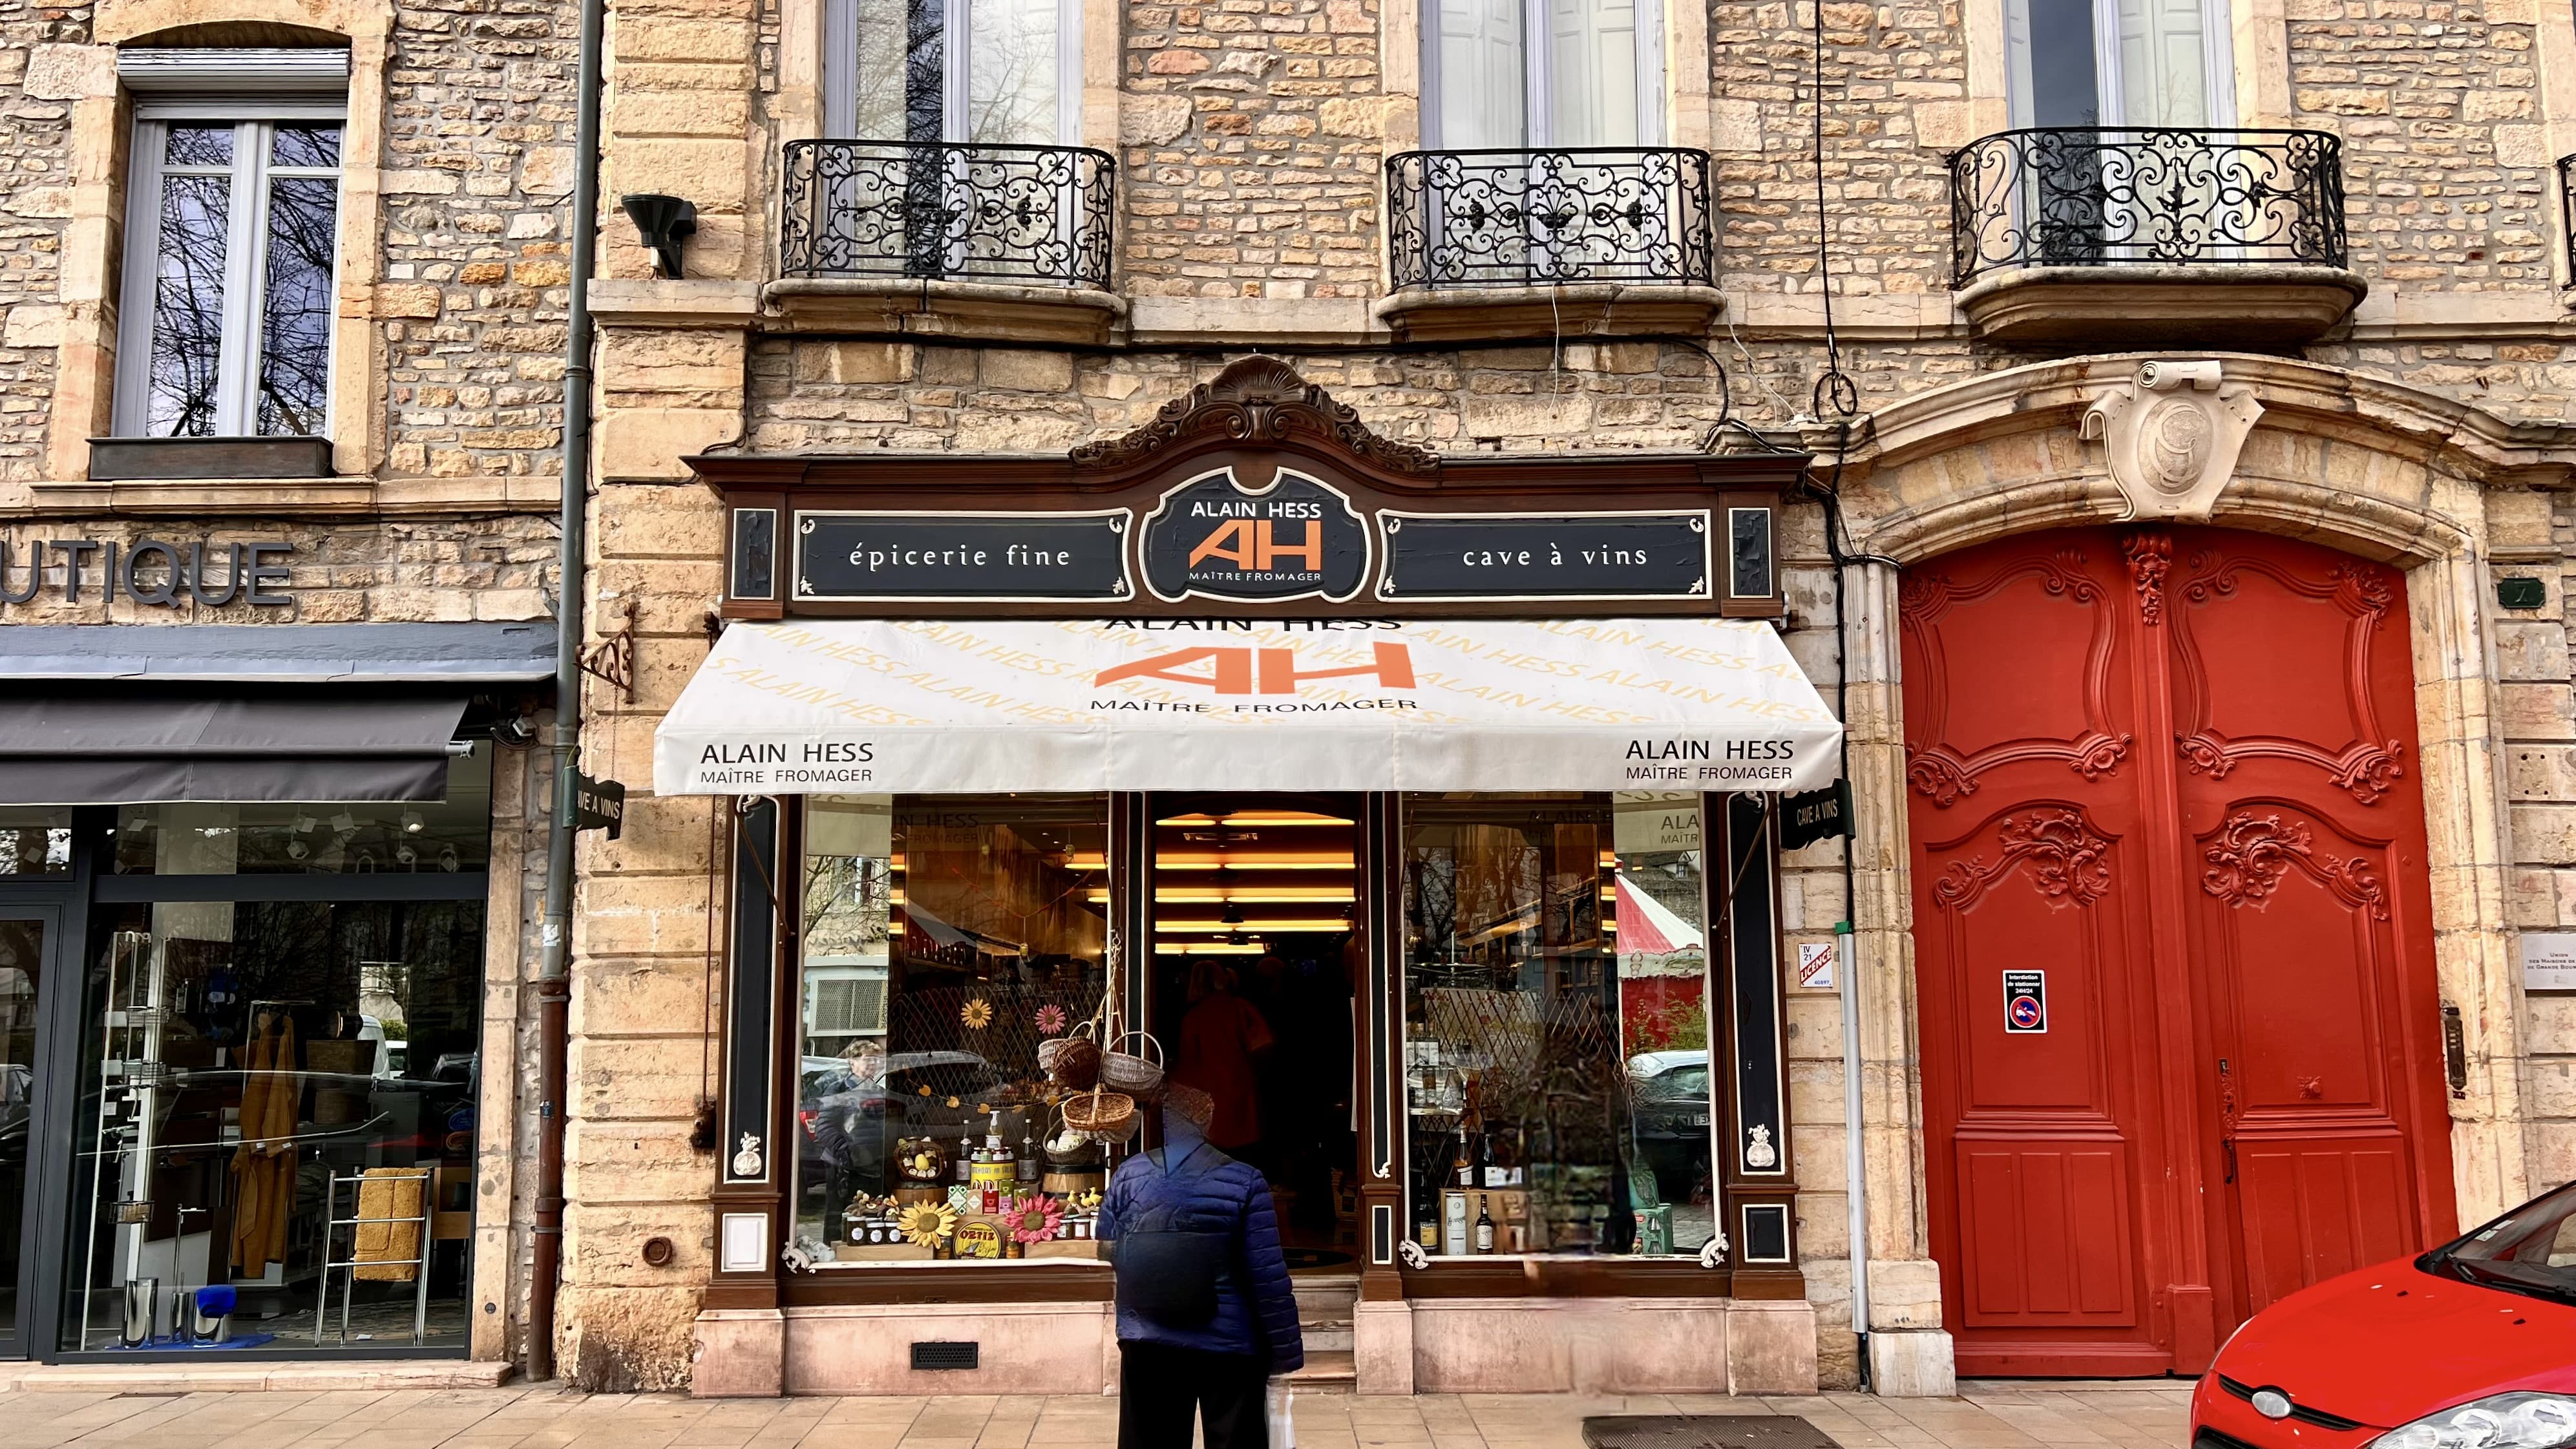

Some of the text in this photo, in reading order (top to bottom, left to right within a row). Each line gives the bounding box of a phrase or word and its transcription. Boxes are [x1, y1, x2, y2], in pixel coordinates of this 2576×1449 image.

[1190, 502, 1322, 518] ALAIN HESS
[849, 542, 1070, 572] épicerie fine
[1188, 520, 1322, 571] AH
[1462, 542, 1647, 566] cave à vins
[0, 540, 293, 609] UTIQUE
[1188, 571, 1322, 582] MAÎTRE FROMAGER
[1054, 621, 1154, 647] LAIN
[1104, 619, 1402, 631] ALAIN HESS
[889, 622, 988, 651] LAIN
[975, 645, 1076, 675] HESS
[1644, 640, 1756, 670] HESS
[739, 623, 826, 648] AIN
[810, 640, 909, 673] HESS
[894, 672, 1016, 708] ALAIN
[1094, 641, 1417, 695] AH
[1214, 620, 1318, 655] LAIN
[1414, 671, 1541, 708] ALAIN
[1387, 622, 1487, 654] LAIN
[1482, 648, 1590, 677] HESS
[1585, 670, 1726, 704] ALAIN
[722, 667, 842, 704] ALAIN
[1090, 699, 1417, 712] MAÎTRE FROMAGER
[701, 743, 874, 764] ALAIN HESS
[1625, 740, 1794, 760] ALAIN HESS
[701, 767, 872, 783] MAÎTRE FROMAGER
[1626, 763, 1793, 780] MAÎTRE FROMAGER
[592, 796, 598, 813] A
[601, 797, 620, 820] VINS
[1797, 798, 1838, 826] CAVE A VINS
[1800, 948, 1831, 982] LICENCE
